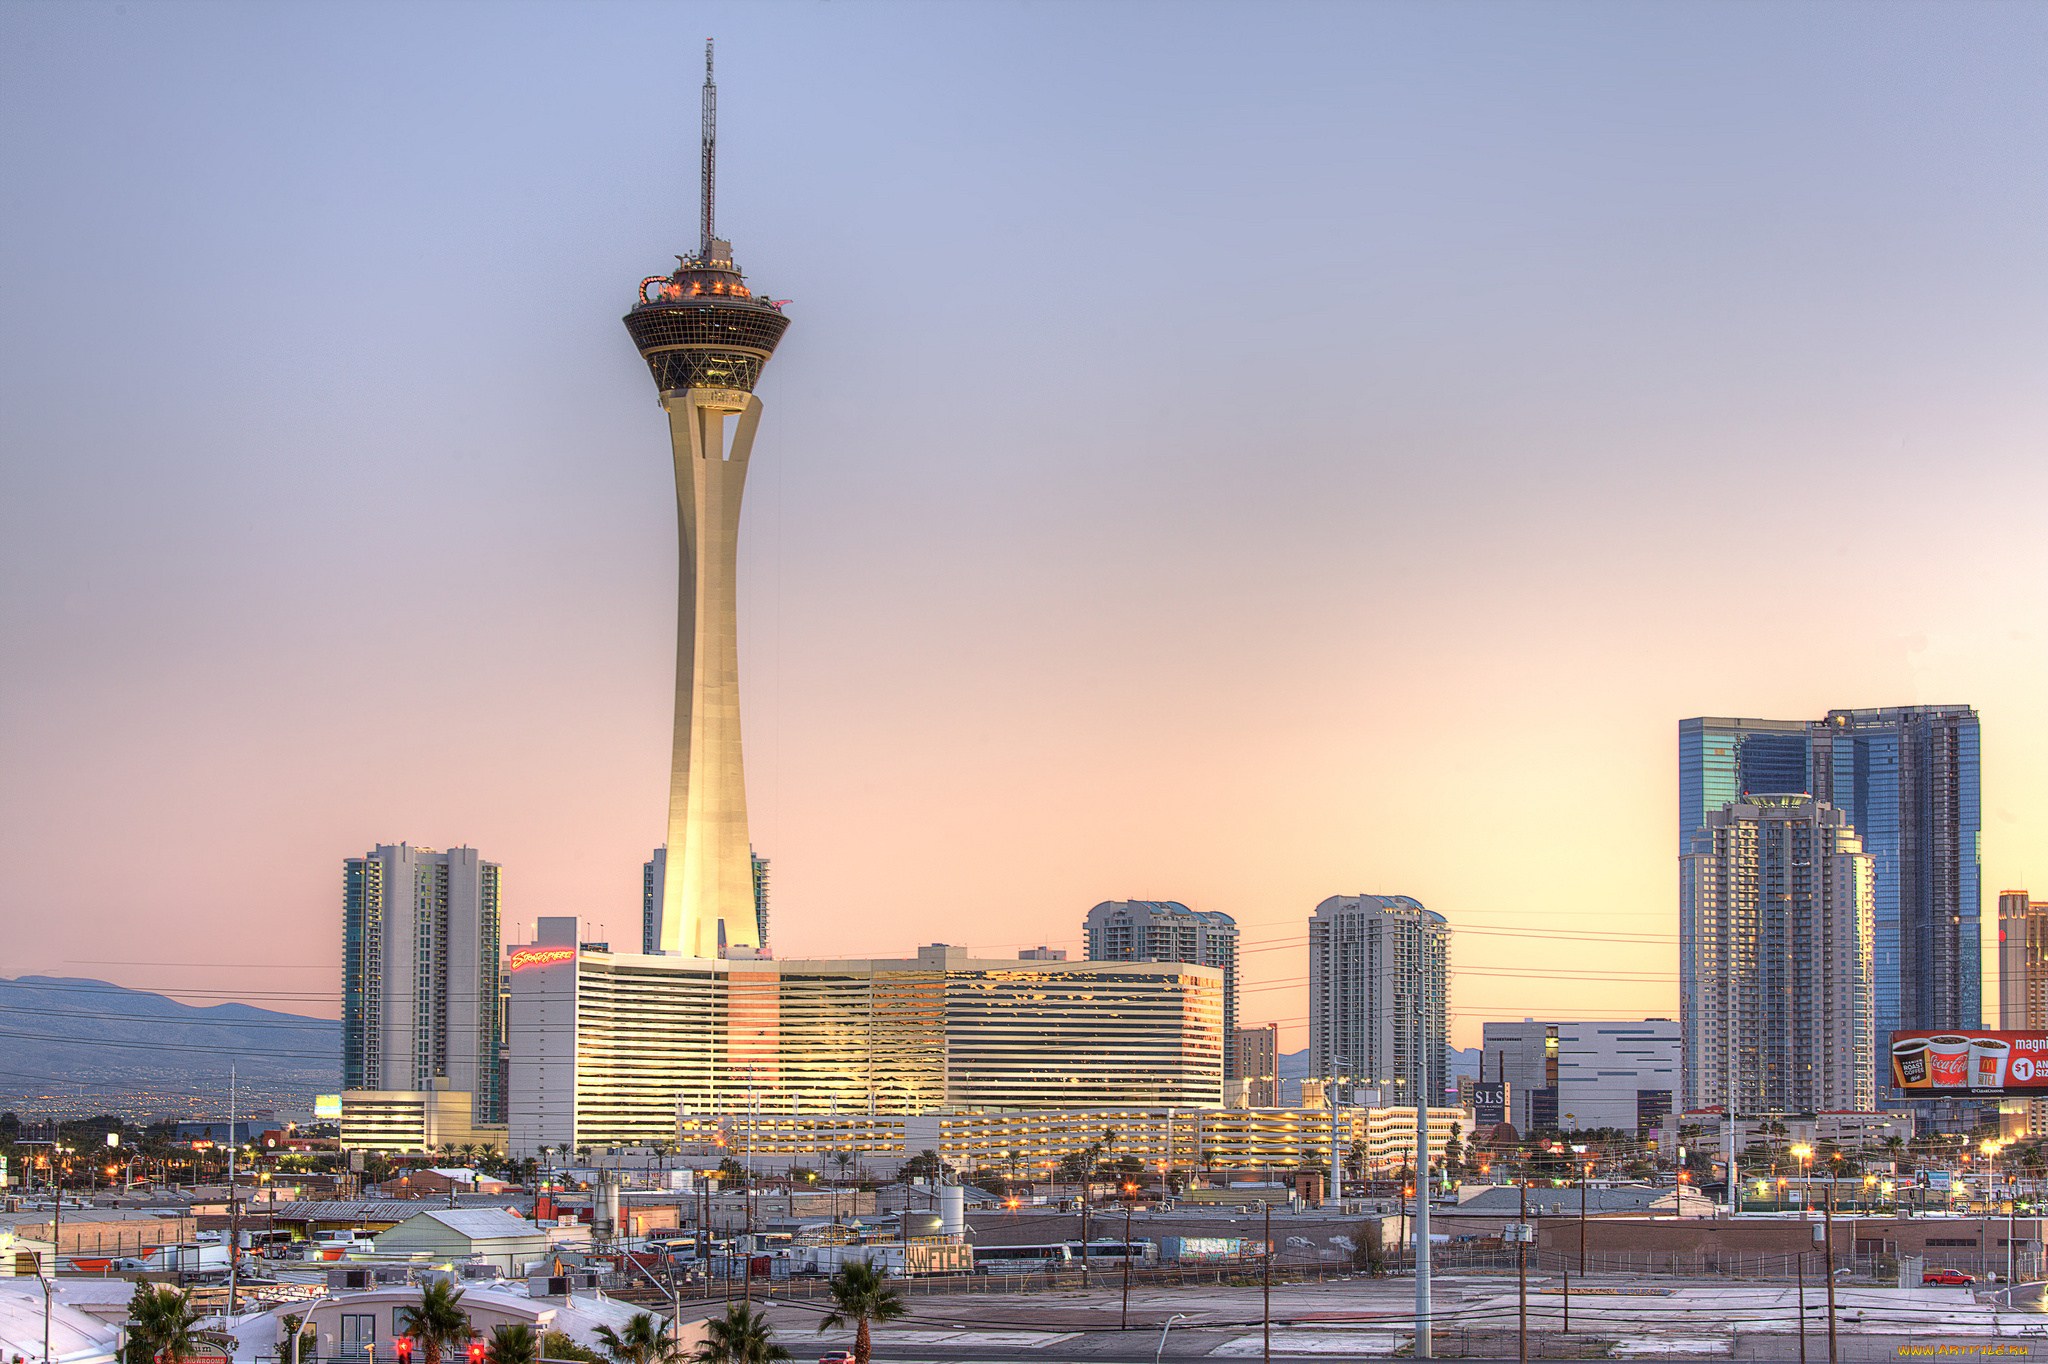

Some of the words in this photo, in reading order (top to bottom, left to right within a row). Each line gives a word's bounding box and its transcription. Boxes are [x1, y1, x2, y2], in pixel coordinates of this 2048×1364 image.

[1903, 1062, 1923, 1071] ROAST
[1904, 1067, 1924, 1076] COFFEE
[2015, 1062, 2029, 1077] $1
[1984, 1074, 1996, 1086] TEA
[1475, 1090, 1504, 1104] SLS
